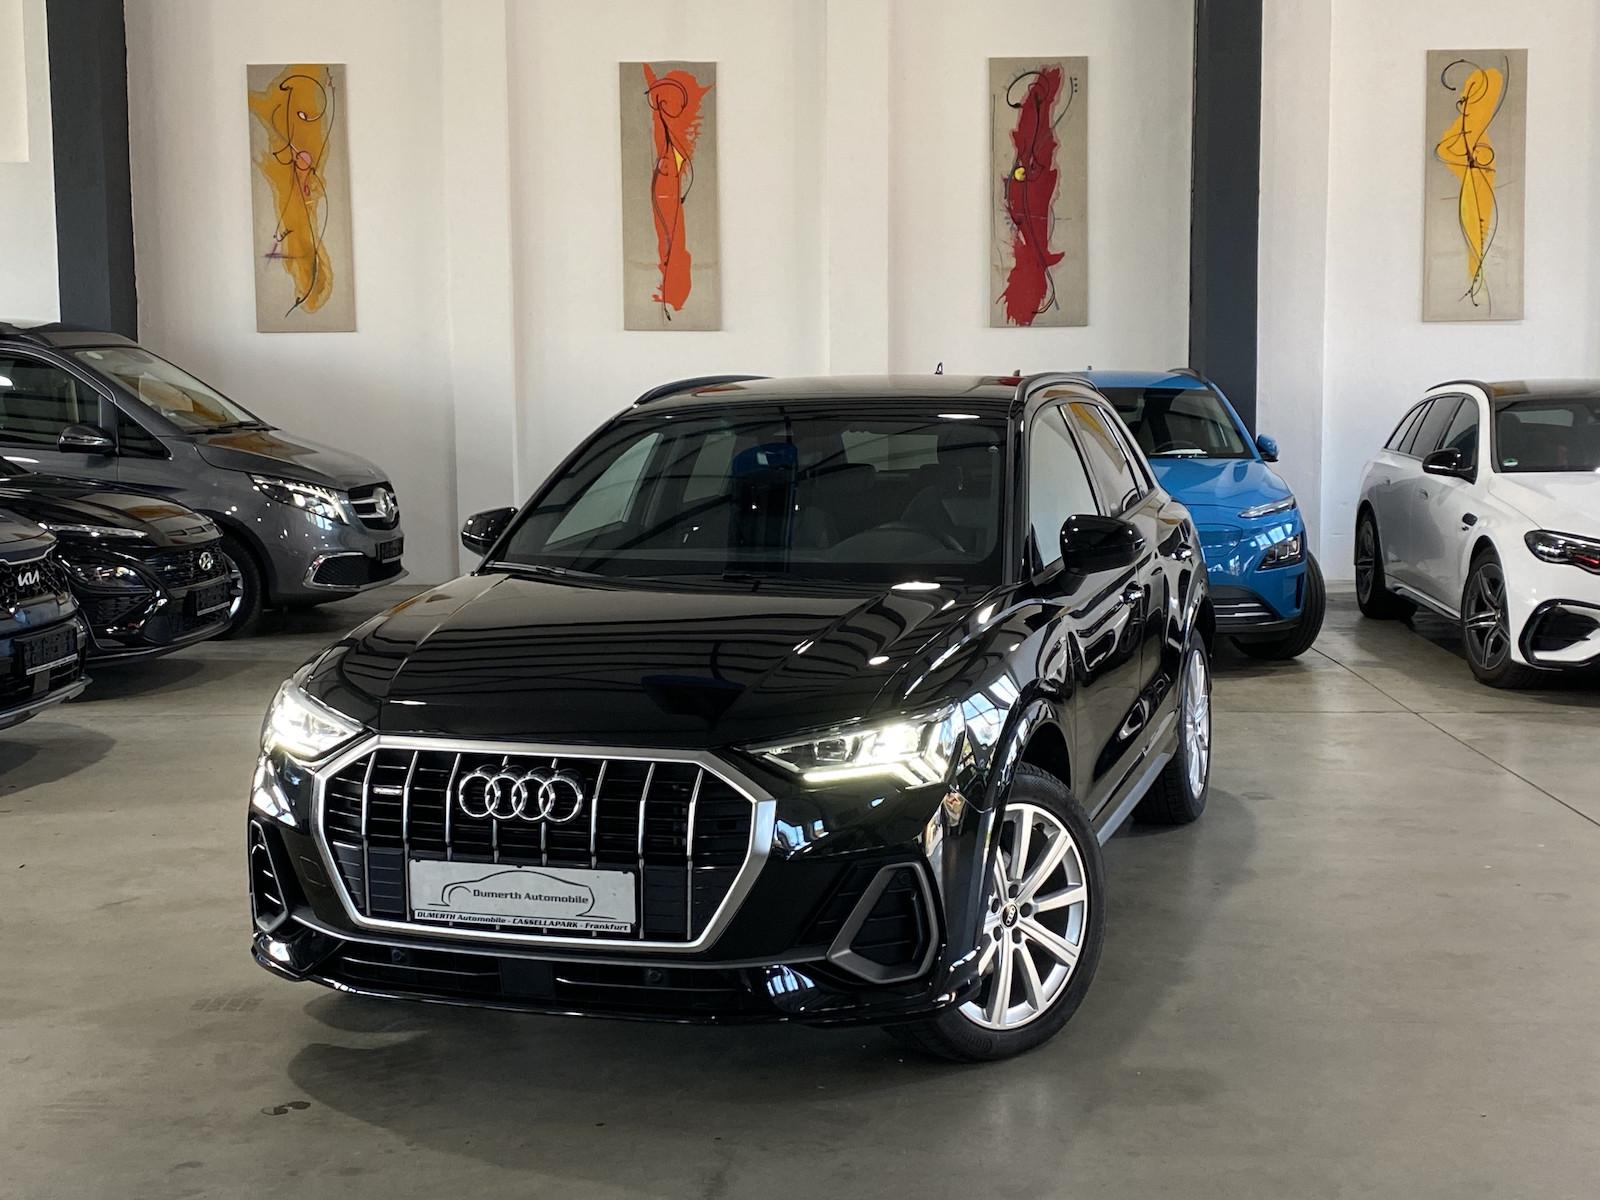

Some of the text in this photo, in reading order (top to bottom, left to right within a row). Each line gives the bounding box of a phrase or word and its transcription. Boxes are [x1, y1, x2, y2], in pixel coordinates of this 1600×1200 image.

[473, 889, 589, 904] Dumerth Automobile
[417, 911, 456, 920] DUMERTH
[456, 914, 506, 923] Automobile
[585, 922, 629, 931] Frankfurt
